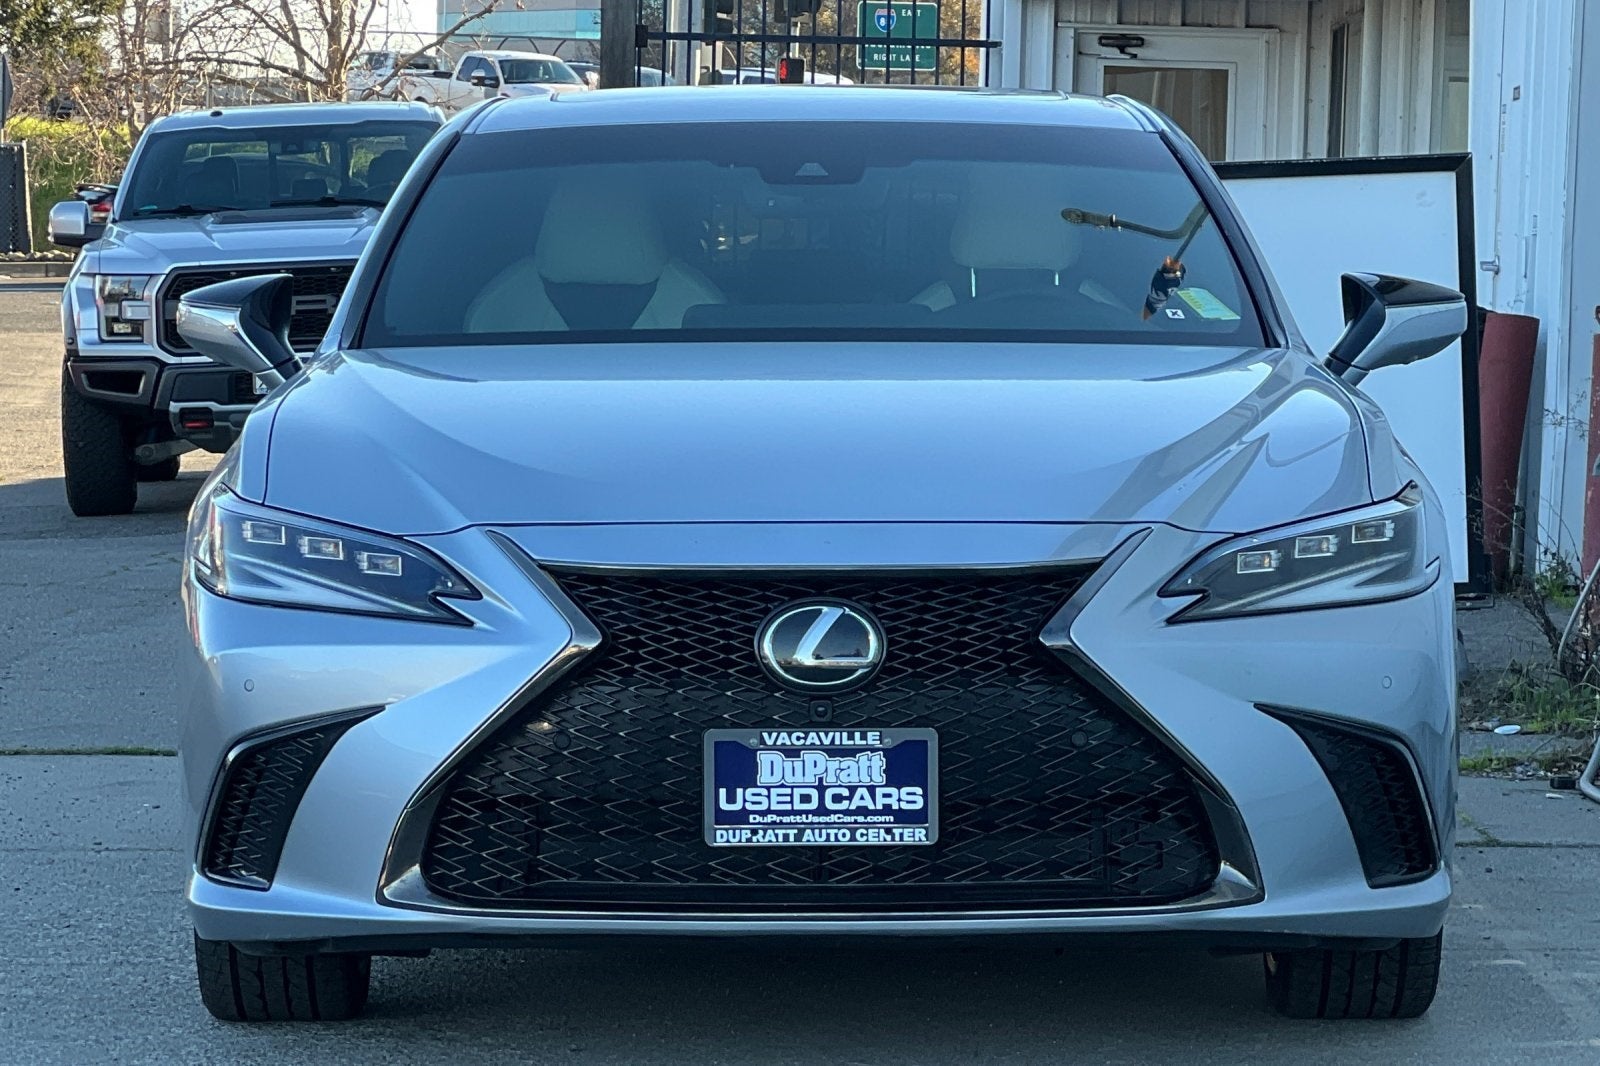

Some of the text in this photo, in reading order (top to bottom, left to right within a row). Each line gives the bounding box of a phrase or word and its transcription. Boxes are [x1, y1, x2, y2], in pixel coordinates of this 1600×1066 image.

[901, 9, 922, 17] EAT
[900, 54, 921, 62] LAE
[761, 731, 881, 746] VACAVILLE
[757, 750, 886, 786] DuPratt
[718, 786, 924, 811] USED CARS
[749, 813, 894, 824] DuPrattUsedCars.com
[802, 828, 851, 842] AUTO
